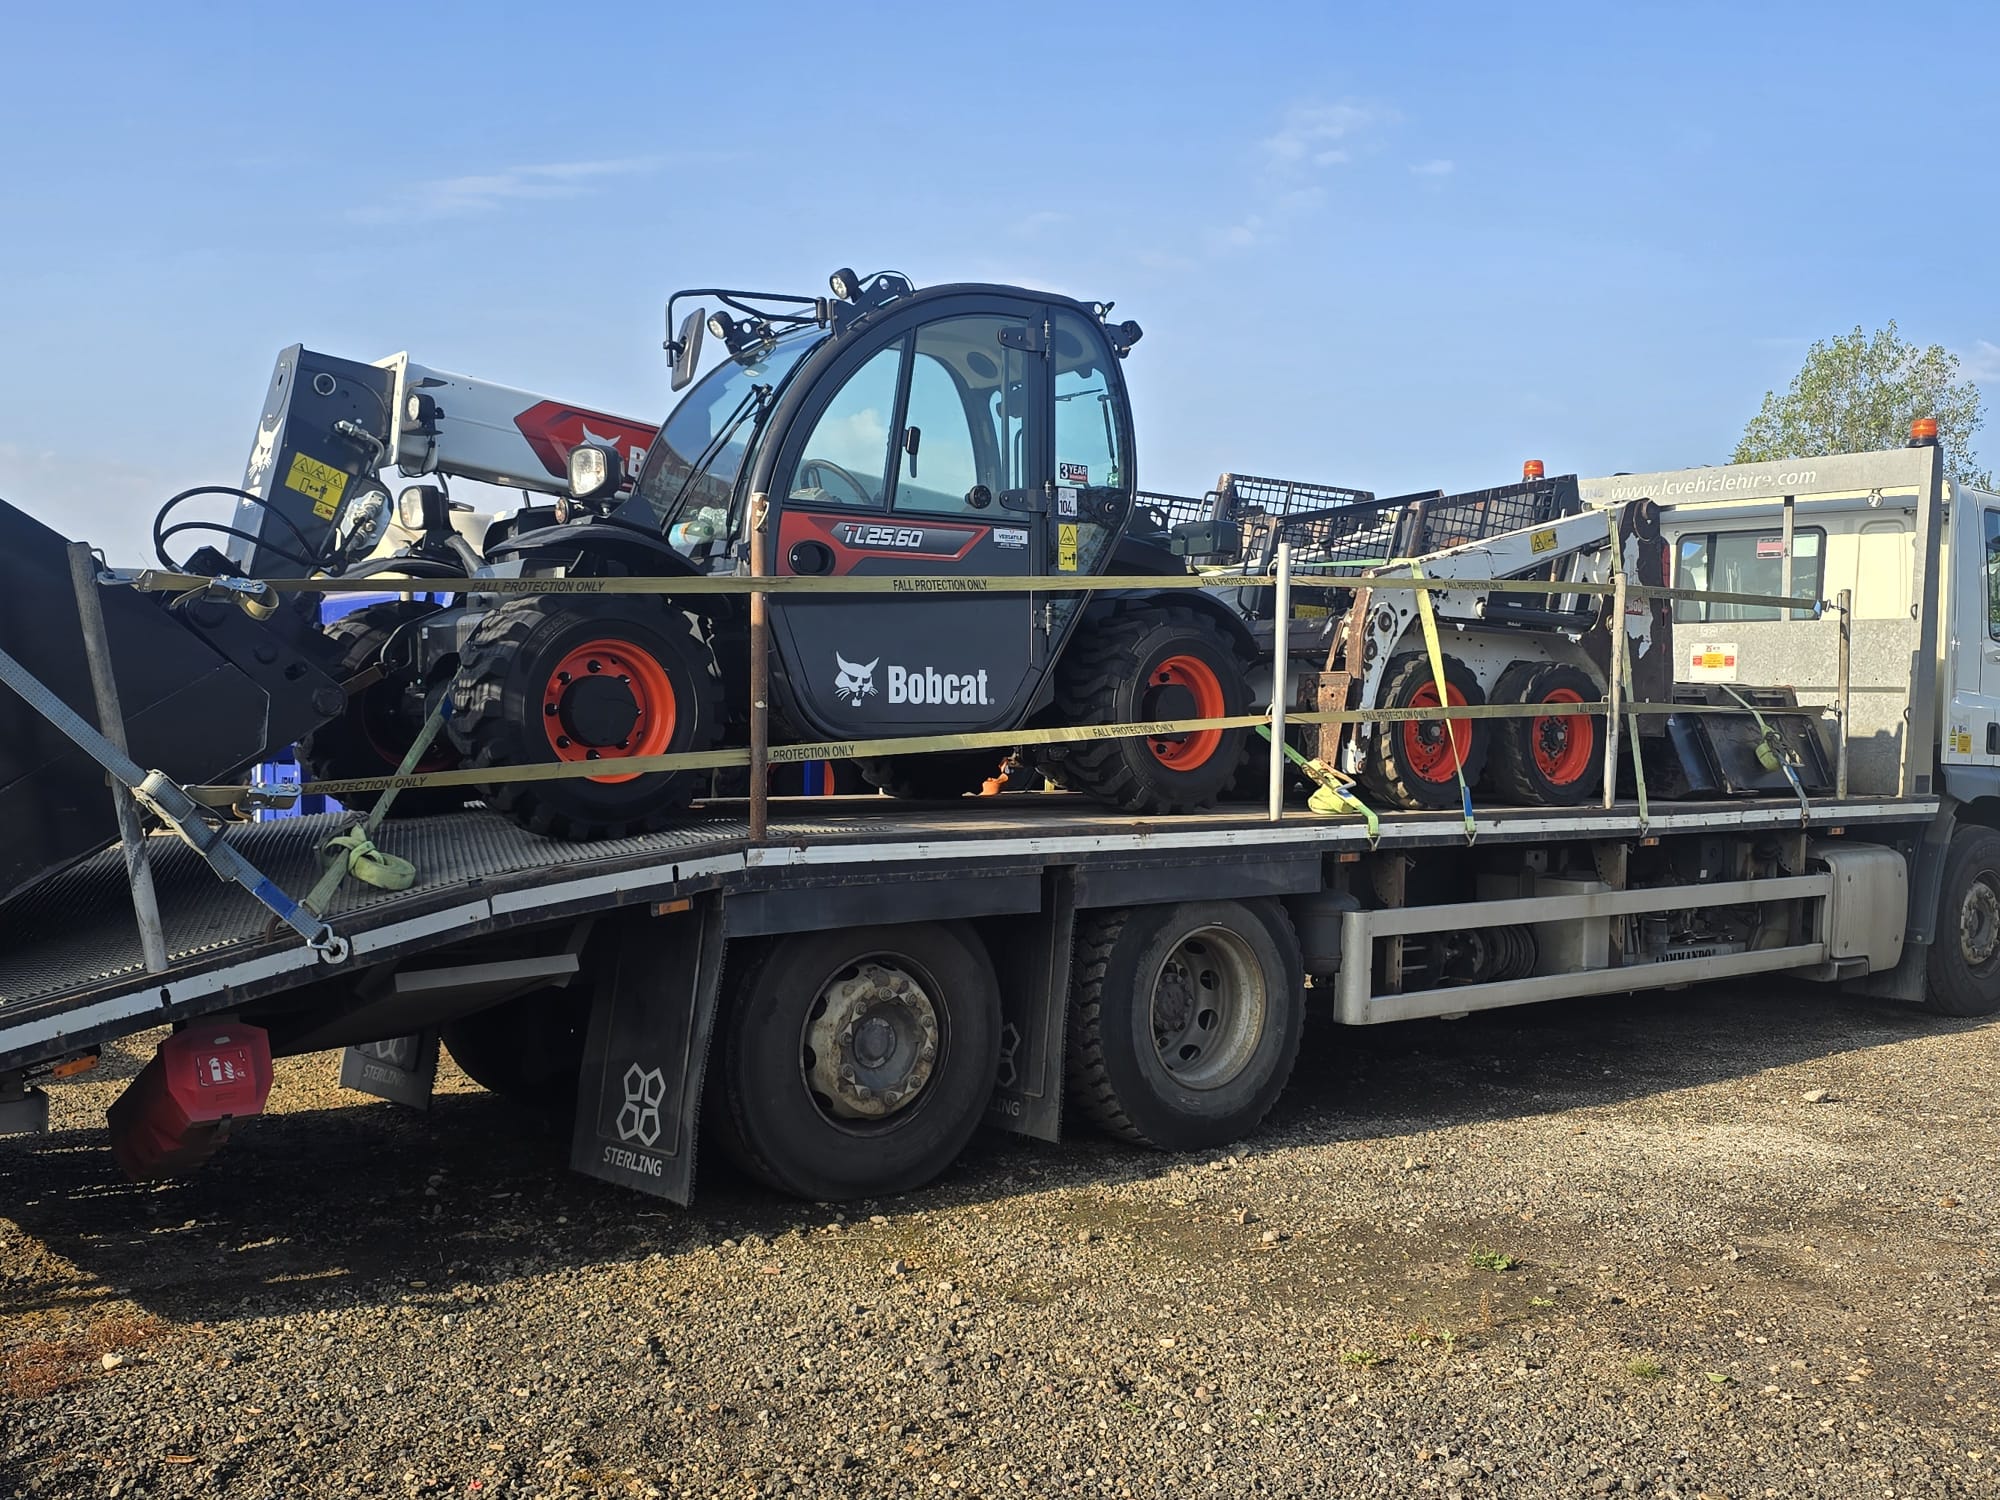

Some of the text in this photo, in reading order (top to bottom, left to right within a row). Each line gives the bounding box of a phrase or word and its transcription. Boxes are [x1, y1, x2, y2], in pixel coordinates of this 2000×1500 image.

[1060, 463, 1069, 479] 3
[1069, 464, 1087, 476] YEAR
[1610, 470, 1817, 499] www.lcvehiclehire.com
[1059, 500, 1072, 514] 104
[844, 524, 924, 548] TL25.60
[471, 581, 606, 592] FALL PROTECTION ONLY
[893, 579, 988, 591] FALL PROTECTION ONLY
[1201, 577, 1219, 586] FALL
[1219, 577, 1259, 585] PROTECTION
[887, 665, 988, 705] Bobcat
[1092, 722, 1175, 738] FALL PROTECTION ONLY
[773, 744, 855, 761] PROTECTION ONLY
[313, 779, 394, 793] PROTECTION
[395, 776, 428, 789] ONLY
[603, 1146, 663, 1177] STERLING
